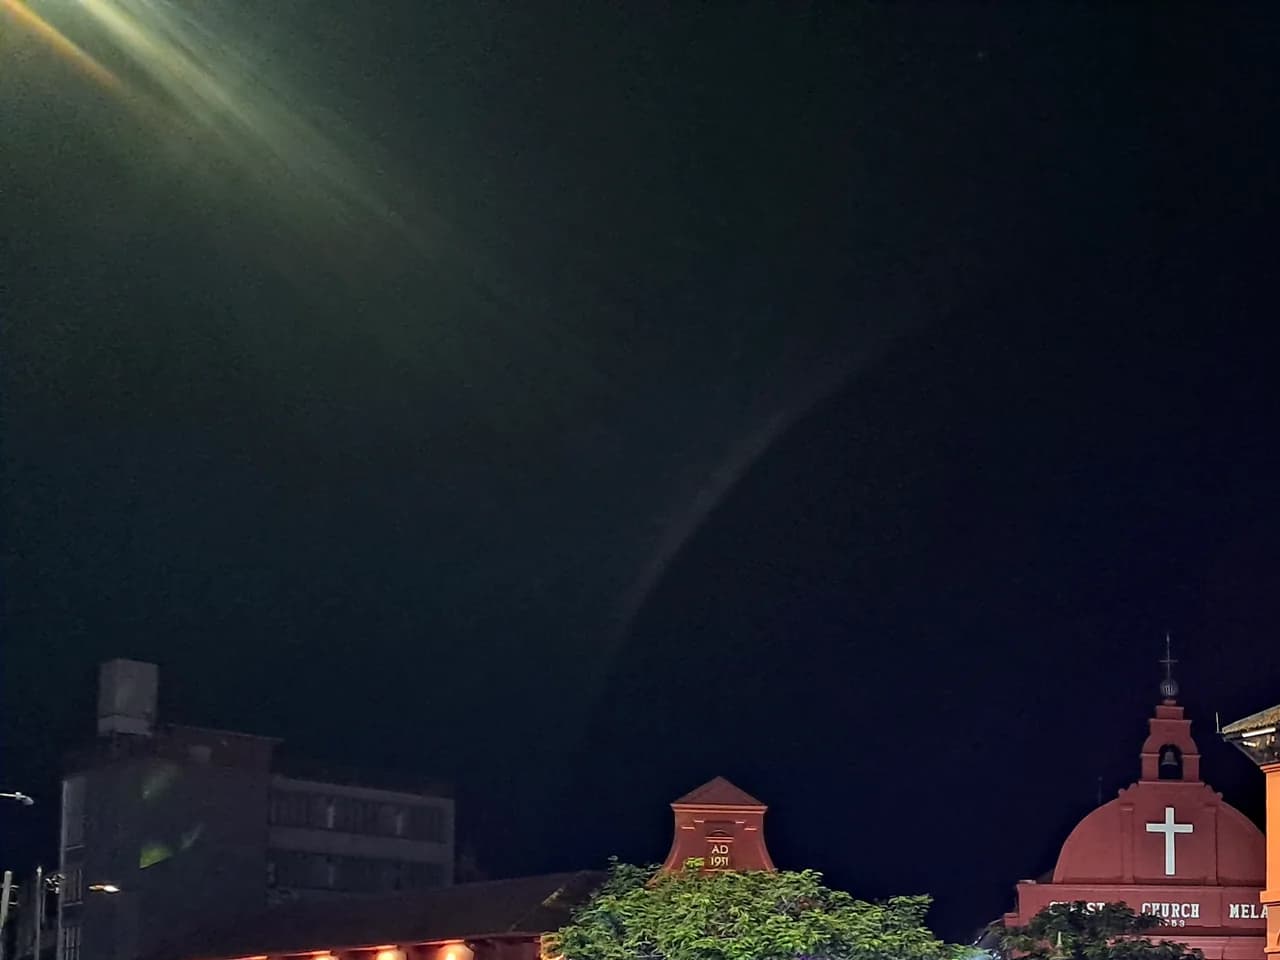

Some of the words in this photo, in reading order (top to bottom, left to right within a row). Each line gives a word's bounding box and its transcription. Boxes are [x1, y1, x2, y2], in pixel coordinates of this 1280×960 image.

[711, 844, 728, 854] AD
[1142, 902, 1200, 918] CHURCH
[1229, 903, 1268, 919] MELA
